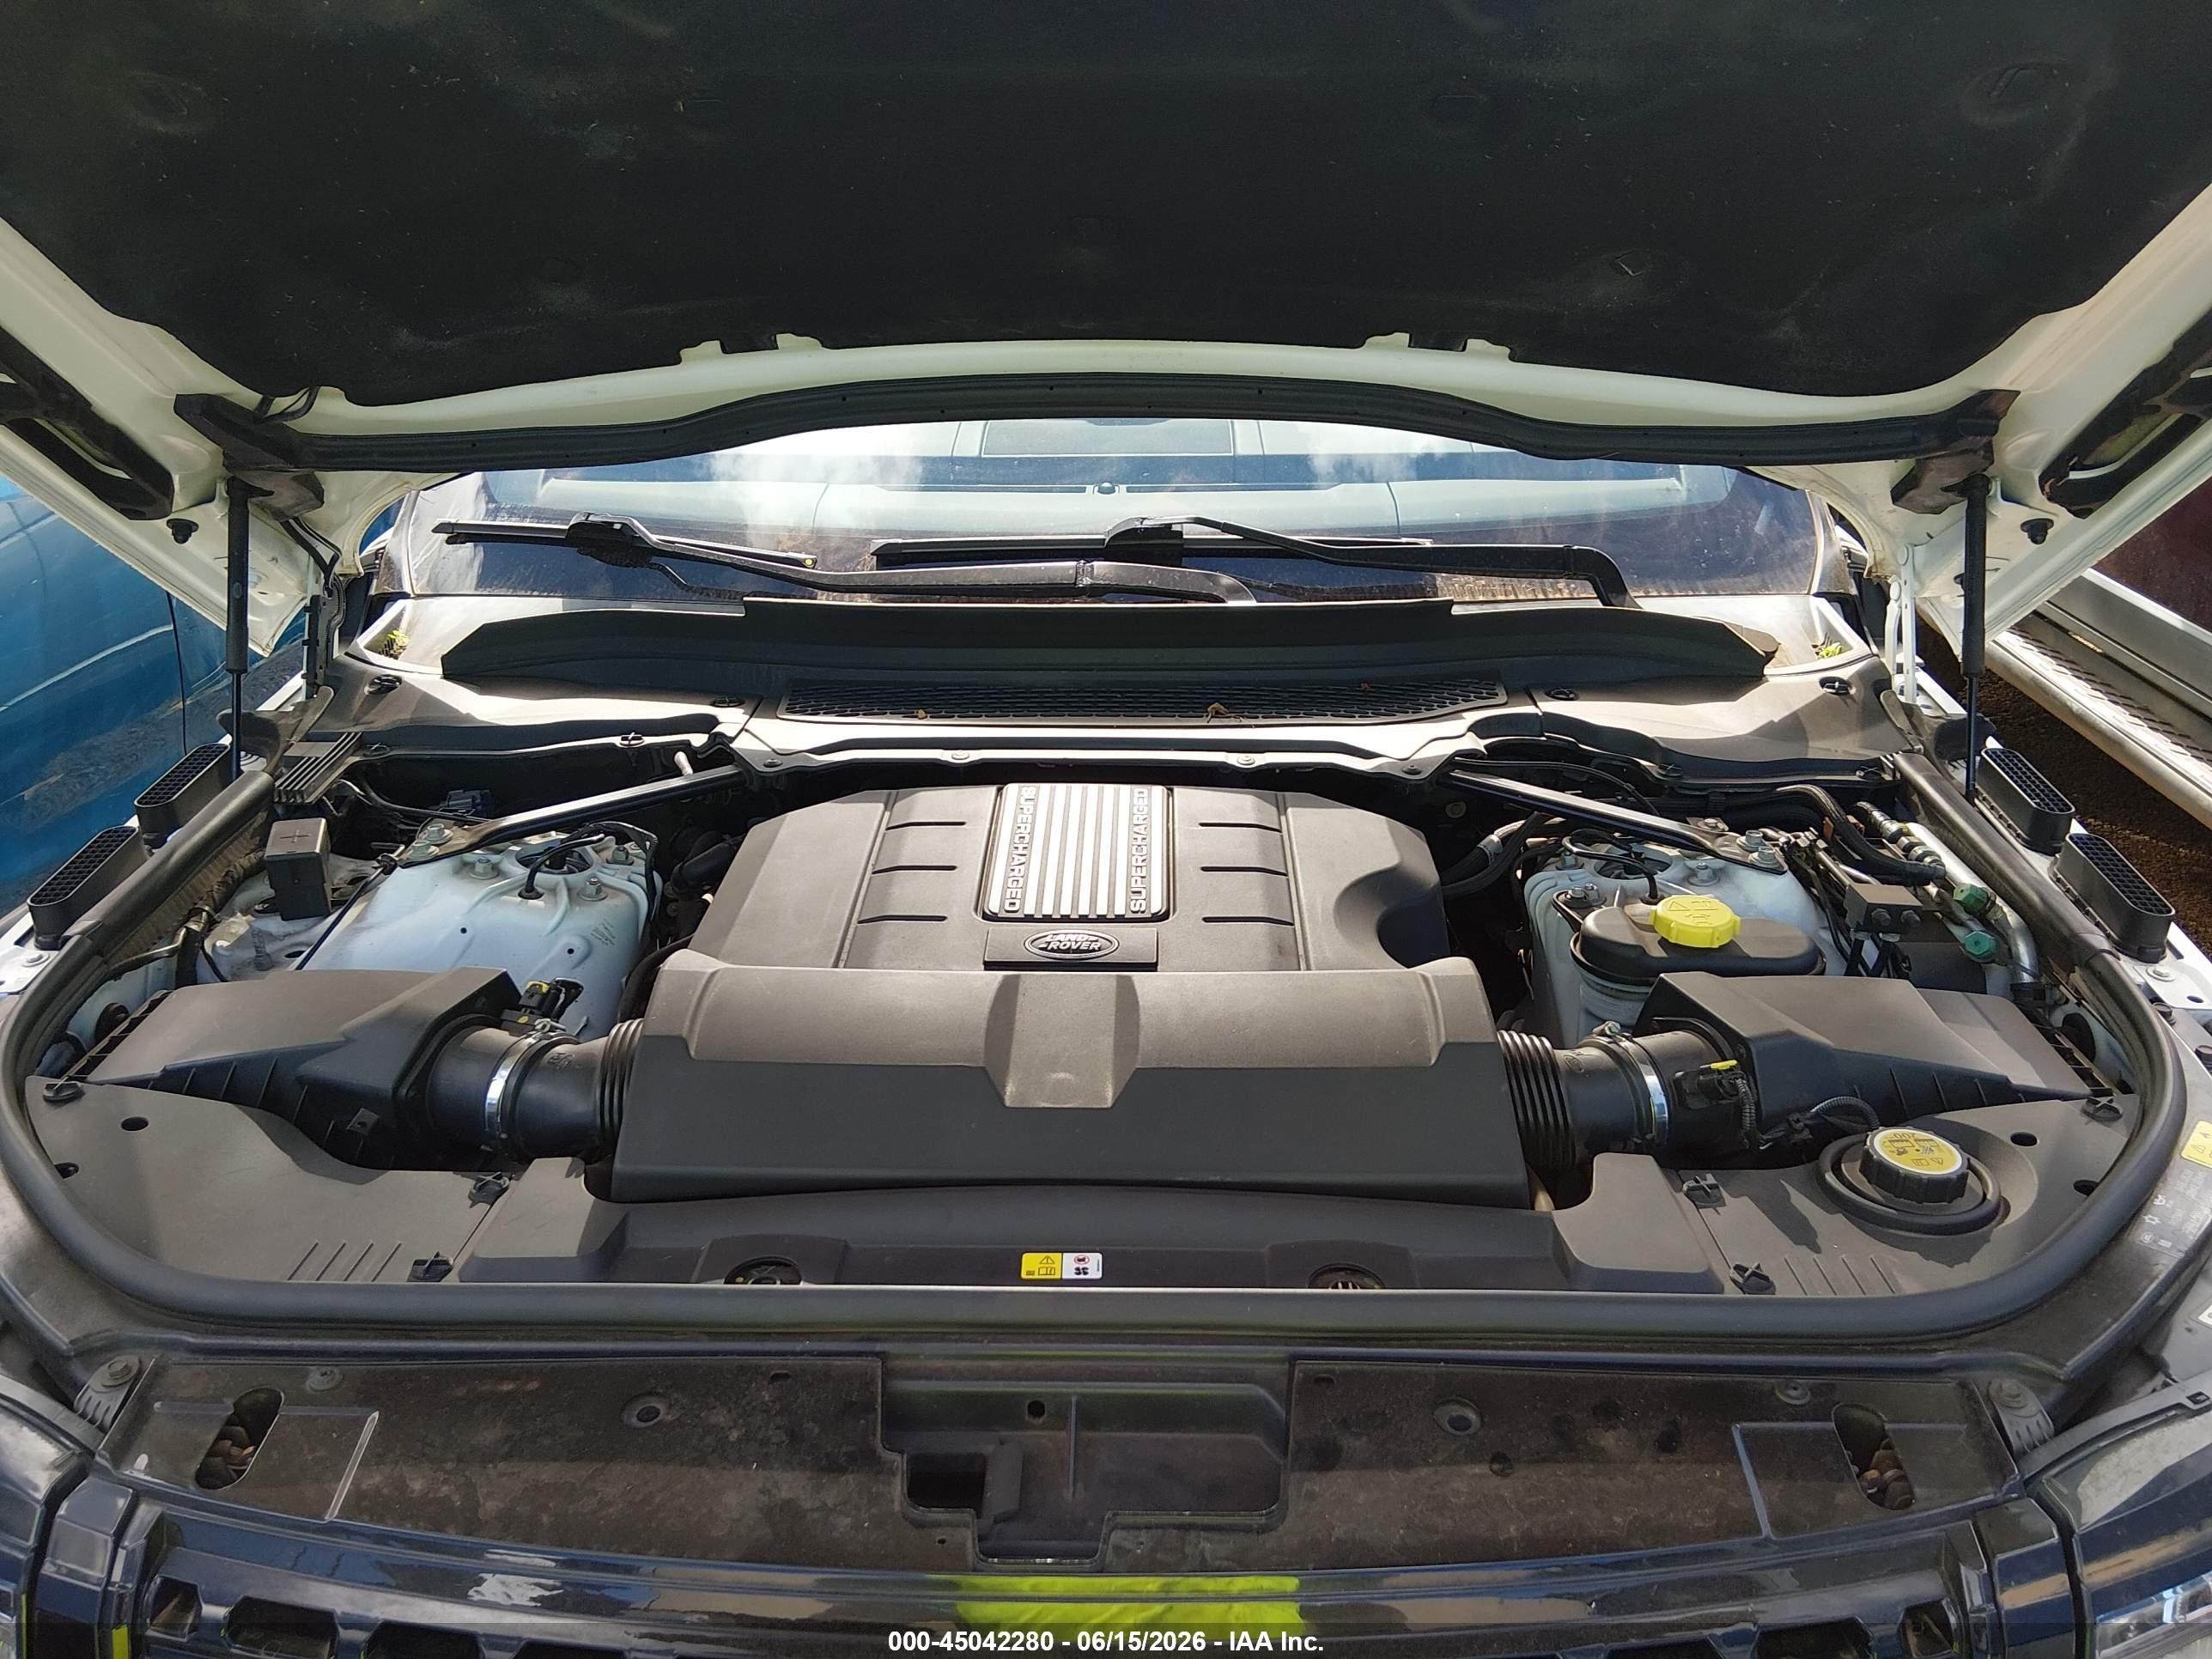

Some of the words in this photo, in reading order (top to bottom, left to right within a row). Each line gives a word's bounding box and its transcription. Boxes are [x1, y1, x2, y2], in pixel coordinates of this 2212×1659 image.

[1004, 786, 1037, 913] SUPERCHARGED
[1129, 787, 1149, 914] SUPERCHARGED
[1045, 933, 1089, 942] LAND
[1047, 941, 1101, 951] ROVER
